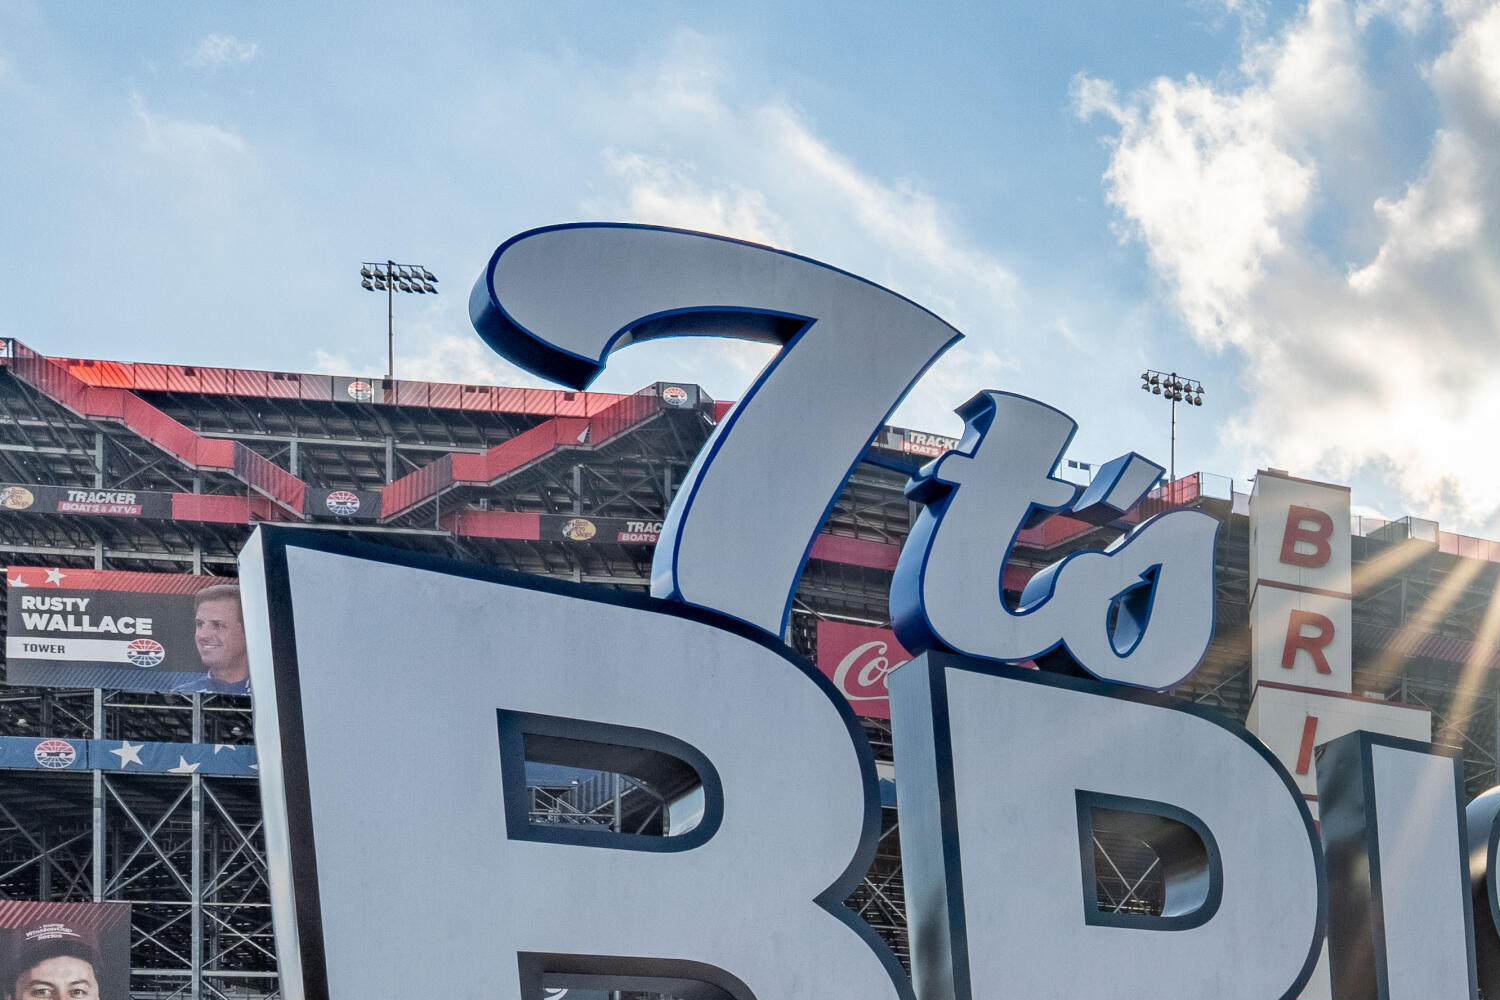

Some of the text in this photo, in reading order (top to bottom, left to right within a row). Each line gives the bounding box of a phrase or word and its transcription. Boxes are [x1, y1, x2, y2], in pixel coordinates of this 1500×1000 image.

[904, 443, 939, 455] BOATS
[470, 223, 1219, 691] It's
[67, 490, 137, 504] TRACKER
[62, 503, 99, 513] BOATS
[621, 534, 656, 542] BOATS
[21, 595, 90, 612] RUSTY
[21, 612, 153, 636] WALLACE
[22, 643, 66, 654] TOWER
[833, 641, 905, 700] Co
